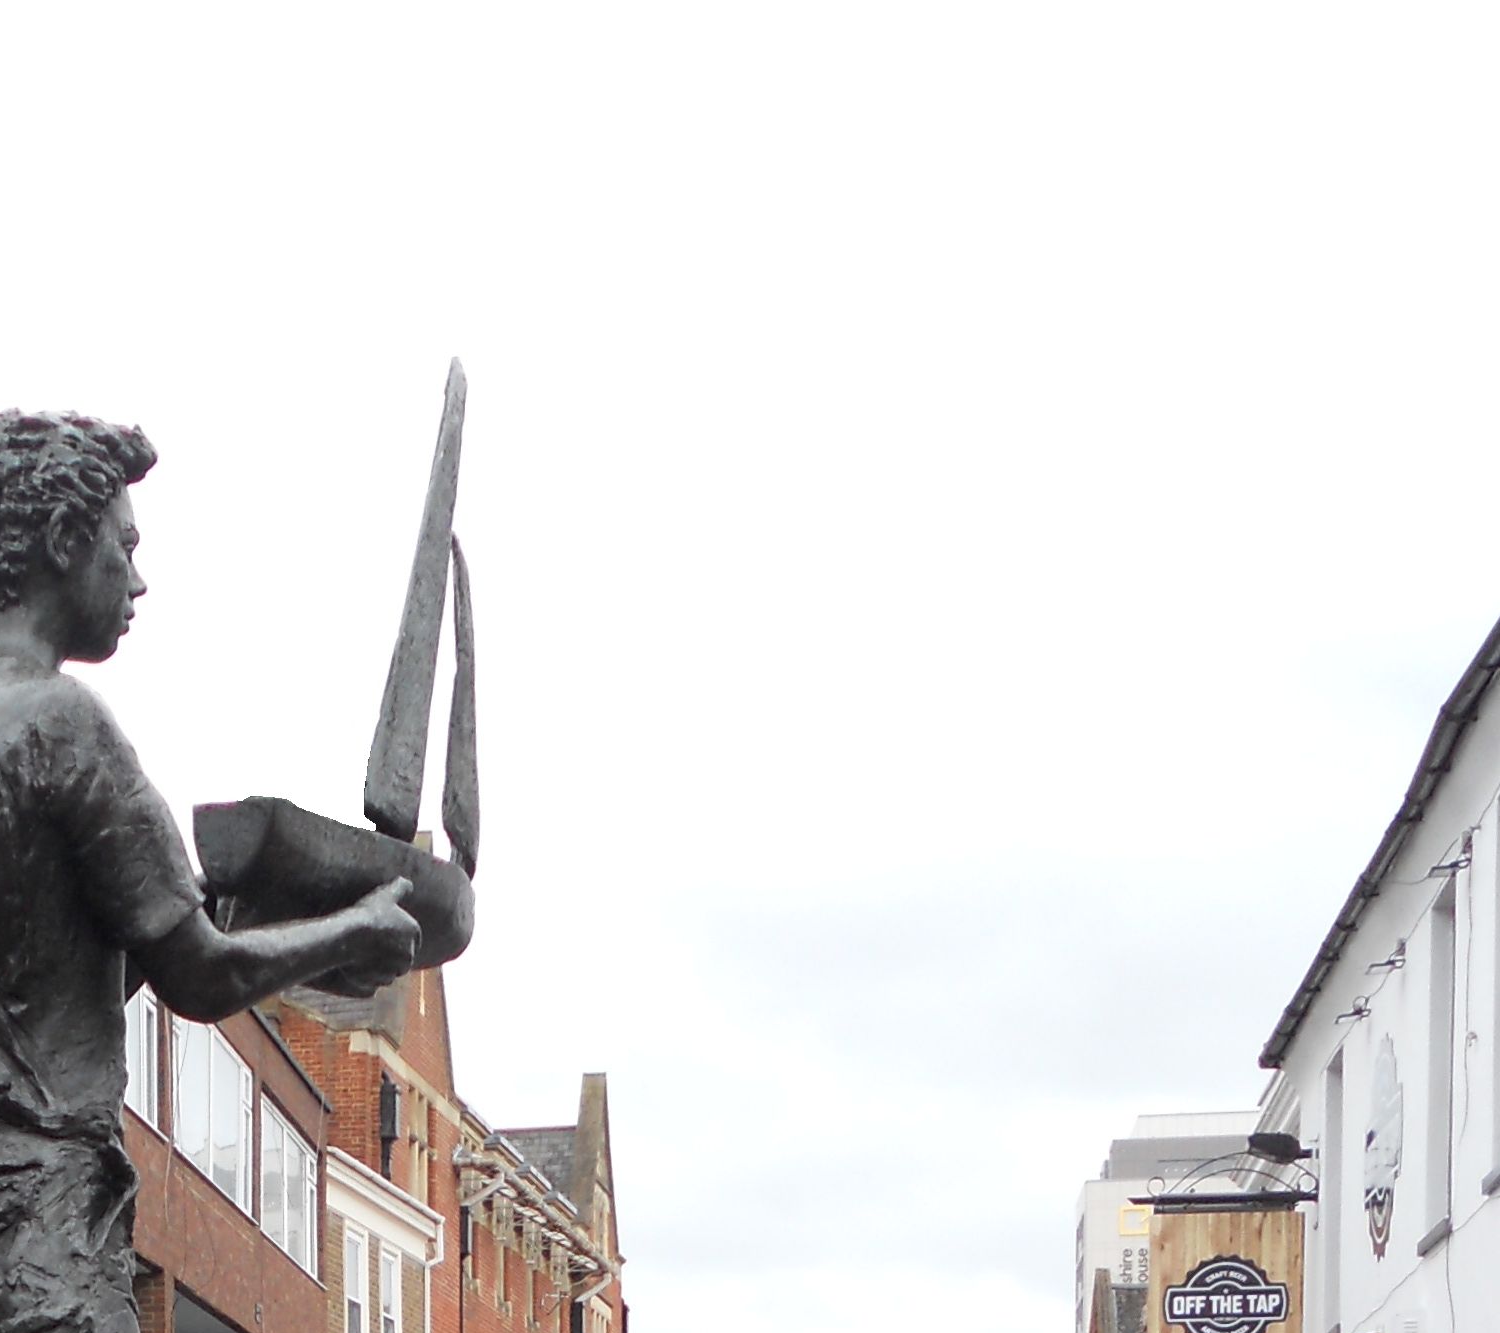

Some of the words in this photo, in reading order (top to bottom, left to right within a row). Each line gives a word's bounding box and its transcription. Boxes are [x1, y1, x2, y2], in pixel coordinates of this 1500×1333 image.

[1172, 1295, 1207, 1315] OFF
[1209, 1294, 1244, 1315] THE
[1246, 1293, 1281, 1314] TAP
